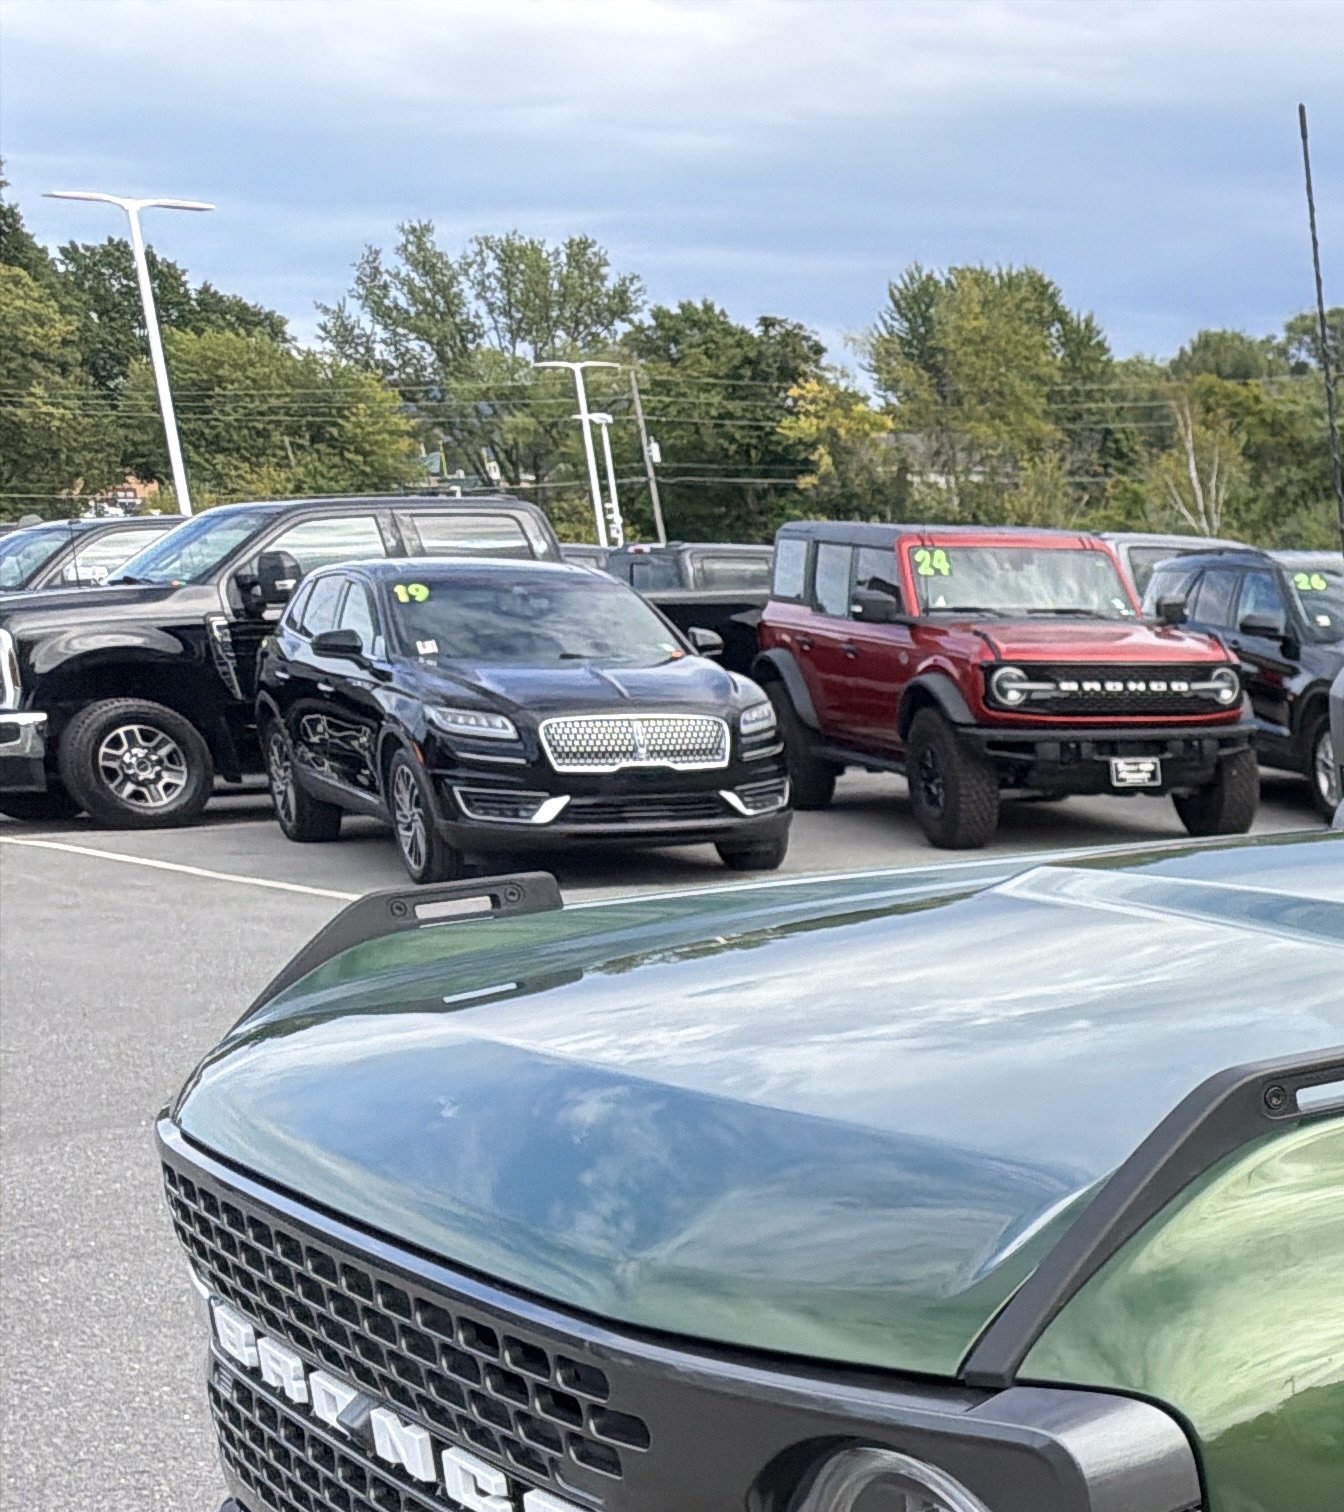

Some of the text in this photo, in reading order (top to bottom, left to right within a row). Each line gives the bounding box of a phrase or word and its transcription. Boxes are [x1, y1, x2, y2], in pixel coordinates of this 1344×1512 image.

[914, 549, 950, 576] 24
[1293, 573, 1327, 590] 26
[393, 584, 430, 602] 19
